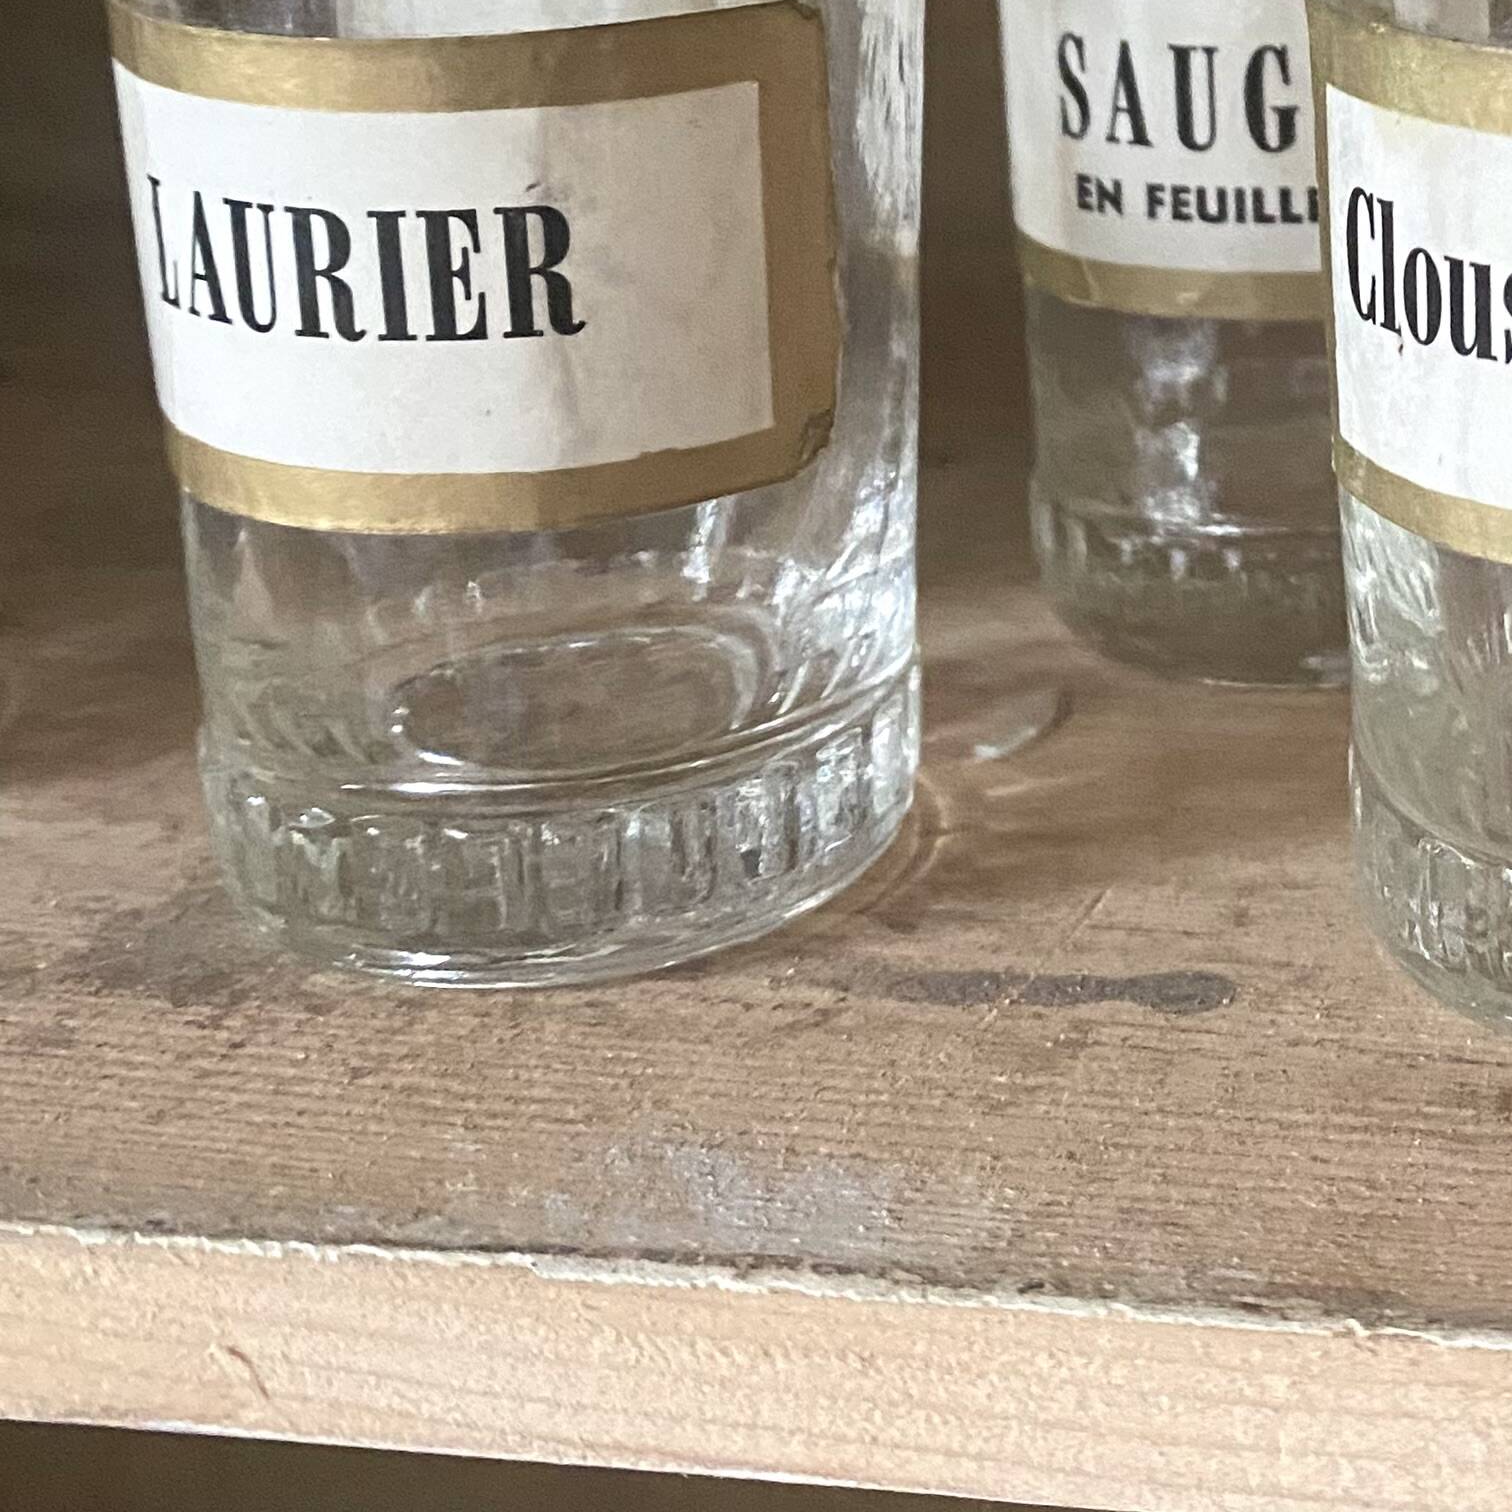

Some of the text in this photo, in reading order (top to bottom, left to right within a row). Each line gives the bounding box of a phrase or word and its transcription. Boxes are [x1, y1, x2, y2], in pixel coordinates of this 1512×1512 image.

[1056, 31, 1301, 154] SAUG
[1075, 173, 1124, 216] EN
[147, 172, 587, 342] LAURIER
